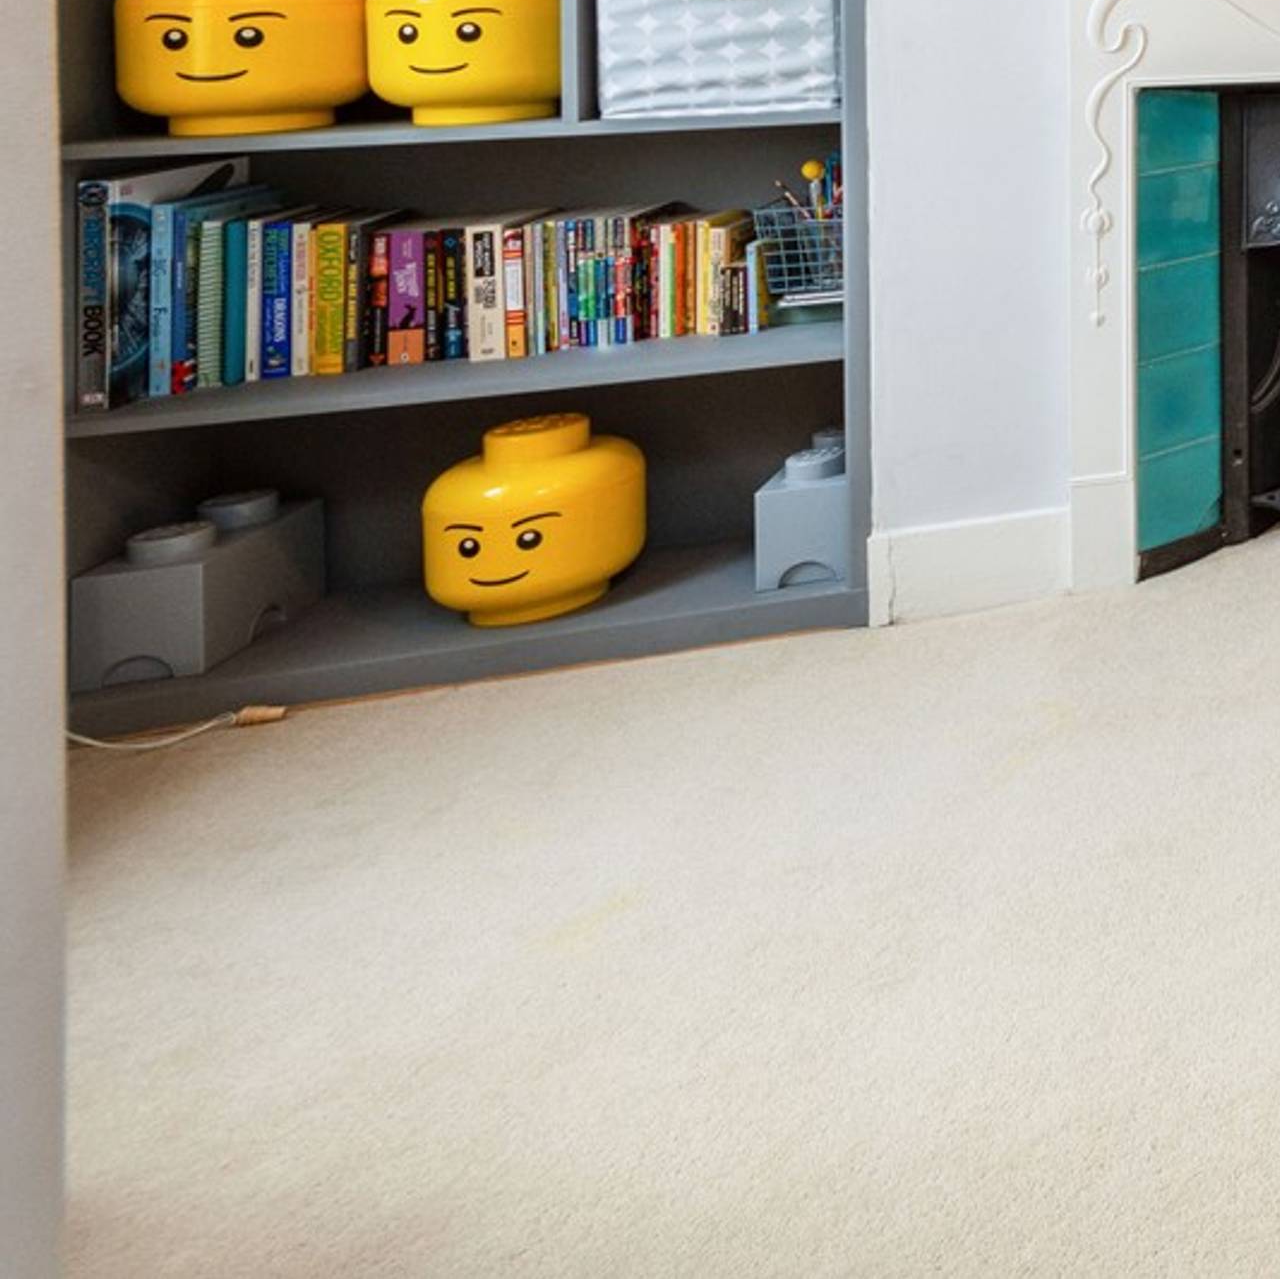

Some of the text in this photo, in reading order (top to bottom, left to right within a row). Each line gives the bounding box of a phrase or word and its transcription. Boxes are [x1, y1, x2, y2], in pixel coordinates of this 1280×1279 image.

[318, 230, 343, 302] OXFORD
[82, 304, 106, 357] BOOK
[272, 297, 288, 343] DRAGONS
